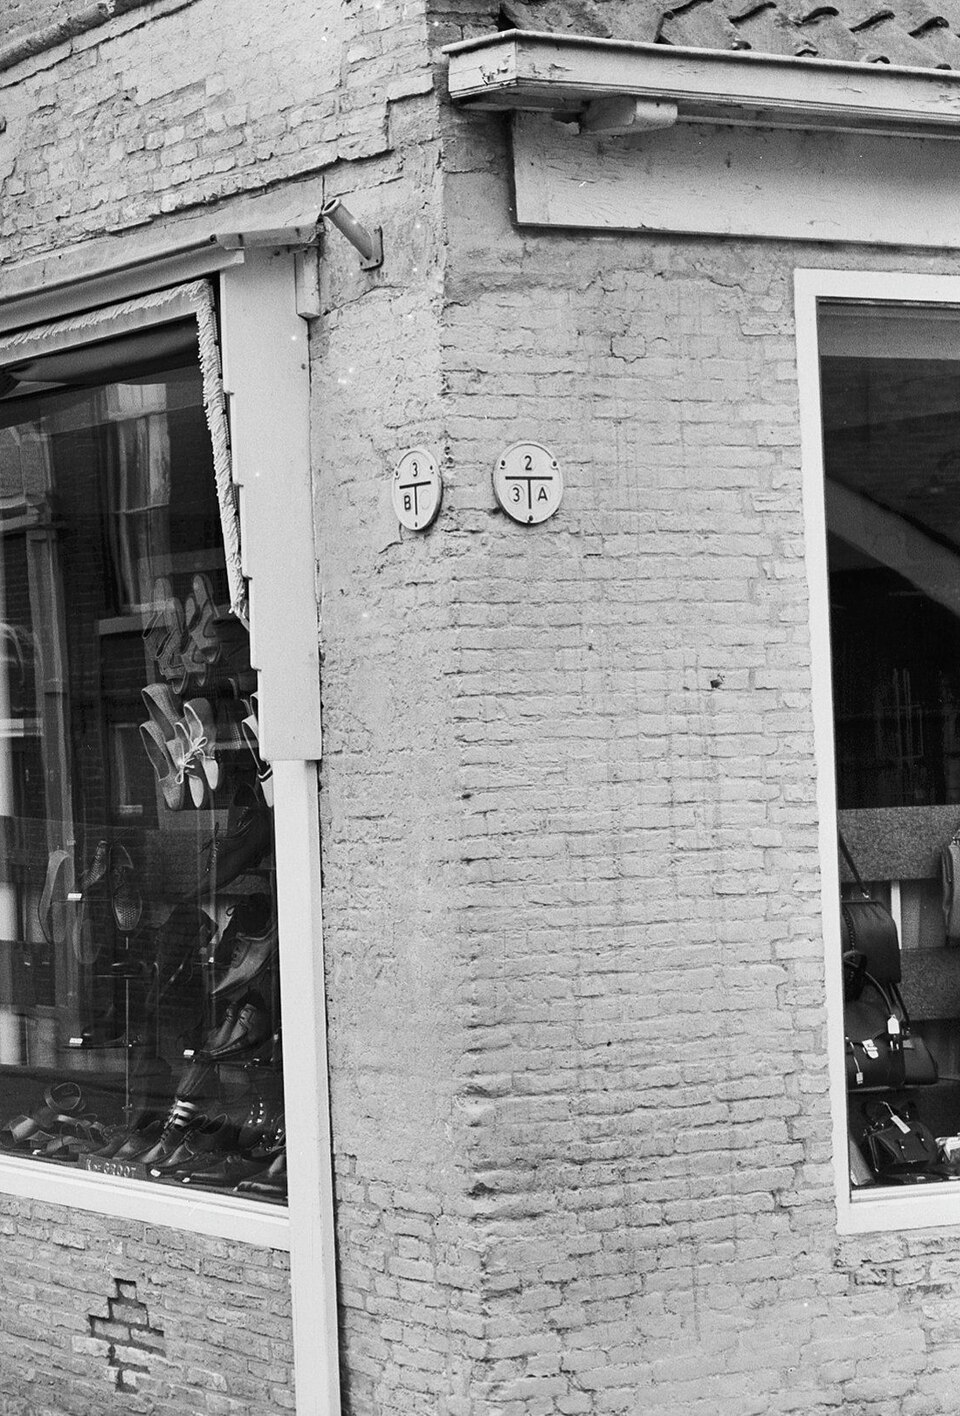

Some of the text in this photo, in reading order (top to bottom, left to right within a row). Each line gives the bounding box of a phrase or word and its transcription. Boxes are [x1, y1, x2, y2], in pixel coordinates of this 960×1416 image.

[412, 462, 419, 477] 3
[524, 455, 533, 471] 2
[512, 487, 548, 502] 3 A
[403, 495, 412, 511] B
